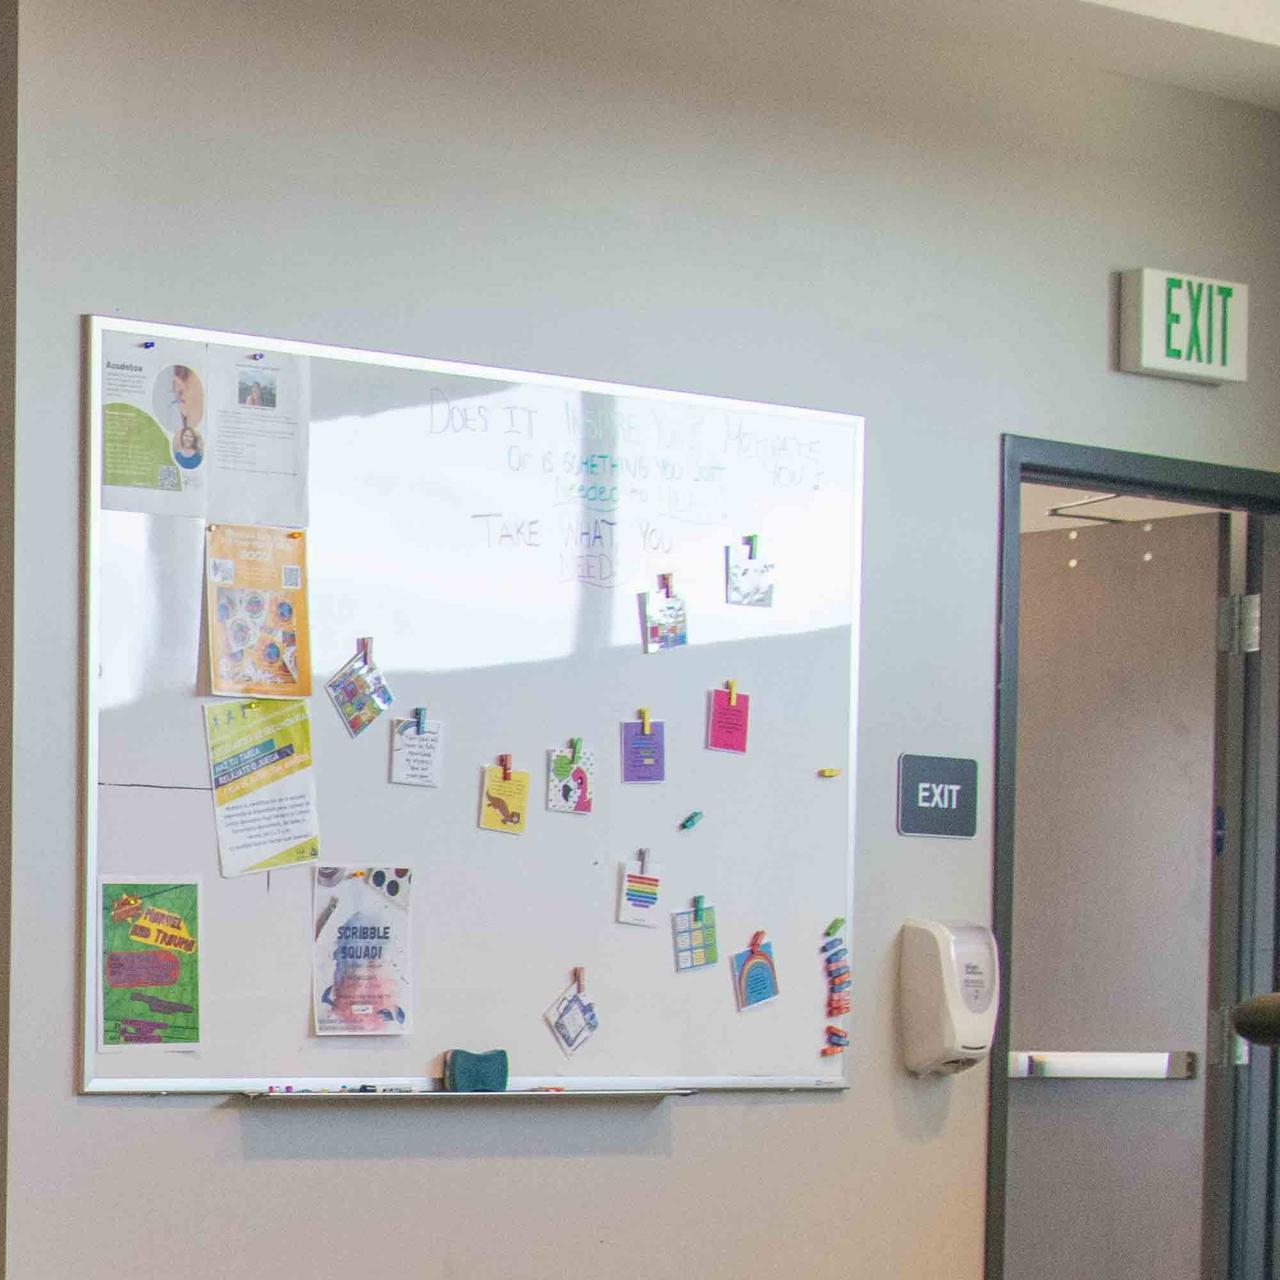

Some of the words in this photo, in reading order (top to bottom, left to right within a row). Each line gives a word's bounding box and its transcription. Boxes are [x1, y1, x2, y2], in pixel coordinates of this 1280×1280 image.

[1165, 277, 1233, 367] EXIT
[428, 385, 489, 434] DOES
[502, 405, 538, 439] IT
[471, 512, 541, 549] TAKE
[564, 518, 618, 548] WHAT
[917, 783, 962, 809] EXIT
[144, 908, 183, 930] MARVEL
[336, 926, 391, 940] SCRIBBLE
[130, 923, 151, 939] AND
[155, 928, 196, 953] TRAUMA
[340, 945, 383, 959] SQUAD!
